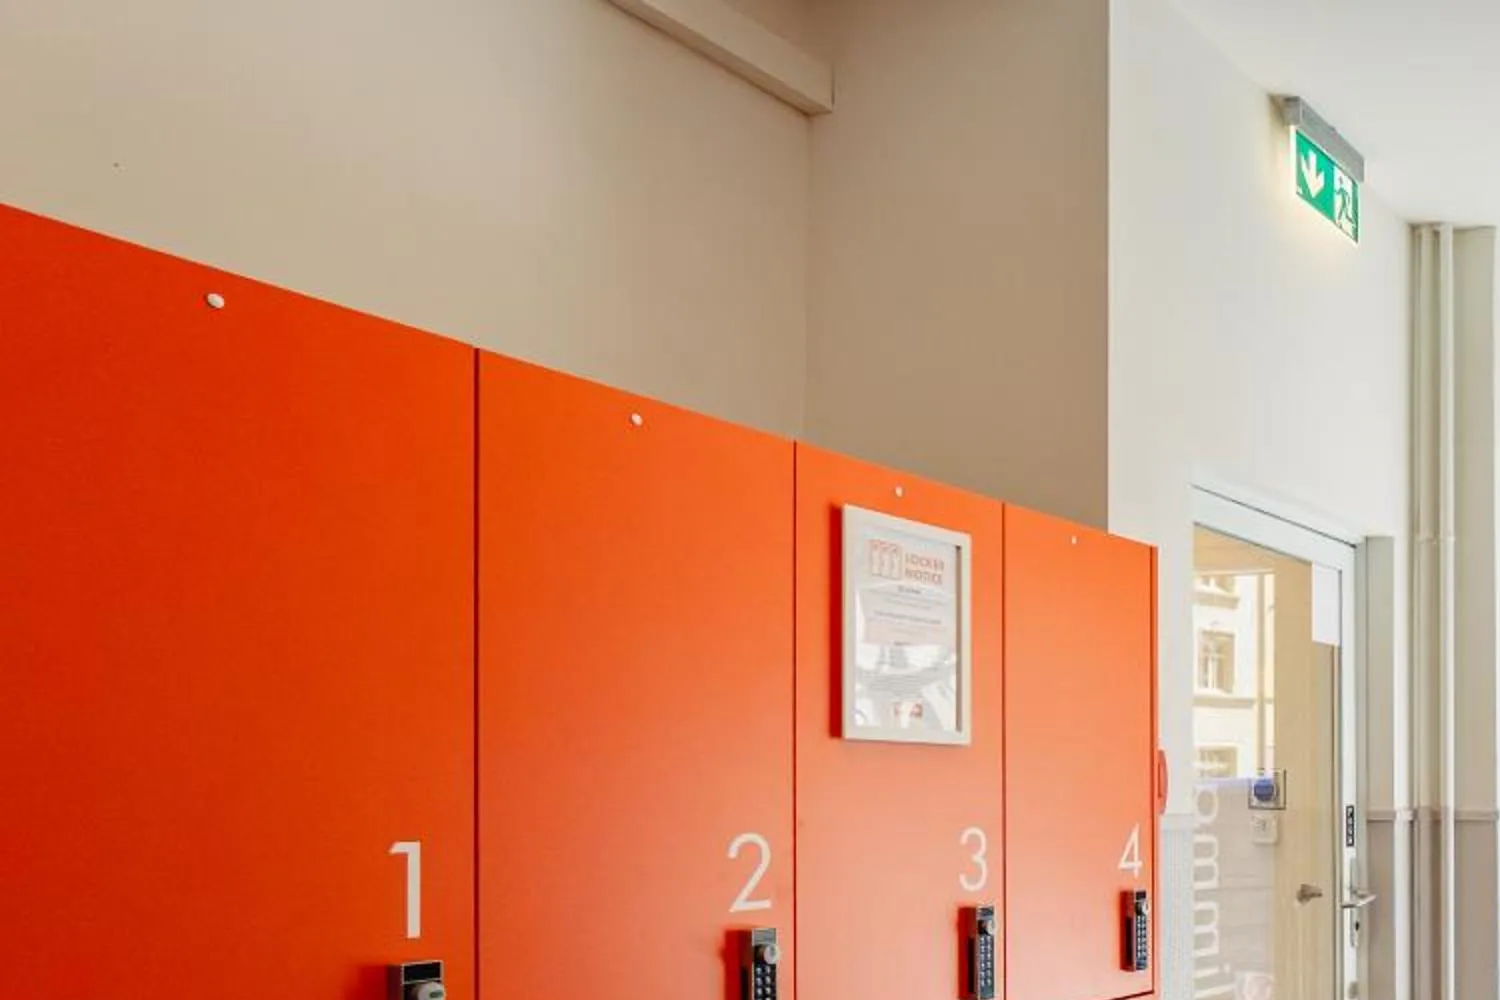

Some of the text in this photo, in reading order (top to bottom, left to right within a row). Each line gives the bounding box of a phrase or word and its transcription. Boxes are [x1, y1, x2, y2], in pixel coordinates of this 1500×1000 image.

[728, 832, 773, 913] 2
[959, 826, 988, 892] 3
[1118, 824, 1143, 877] 4
[389, 840, 421, 940] 1
